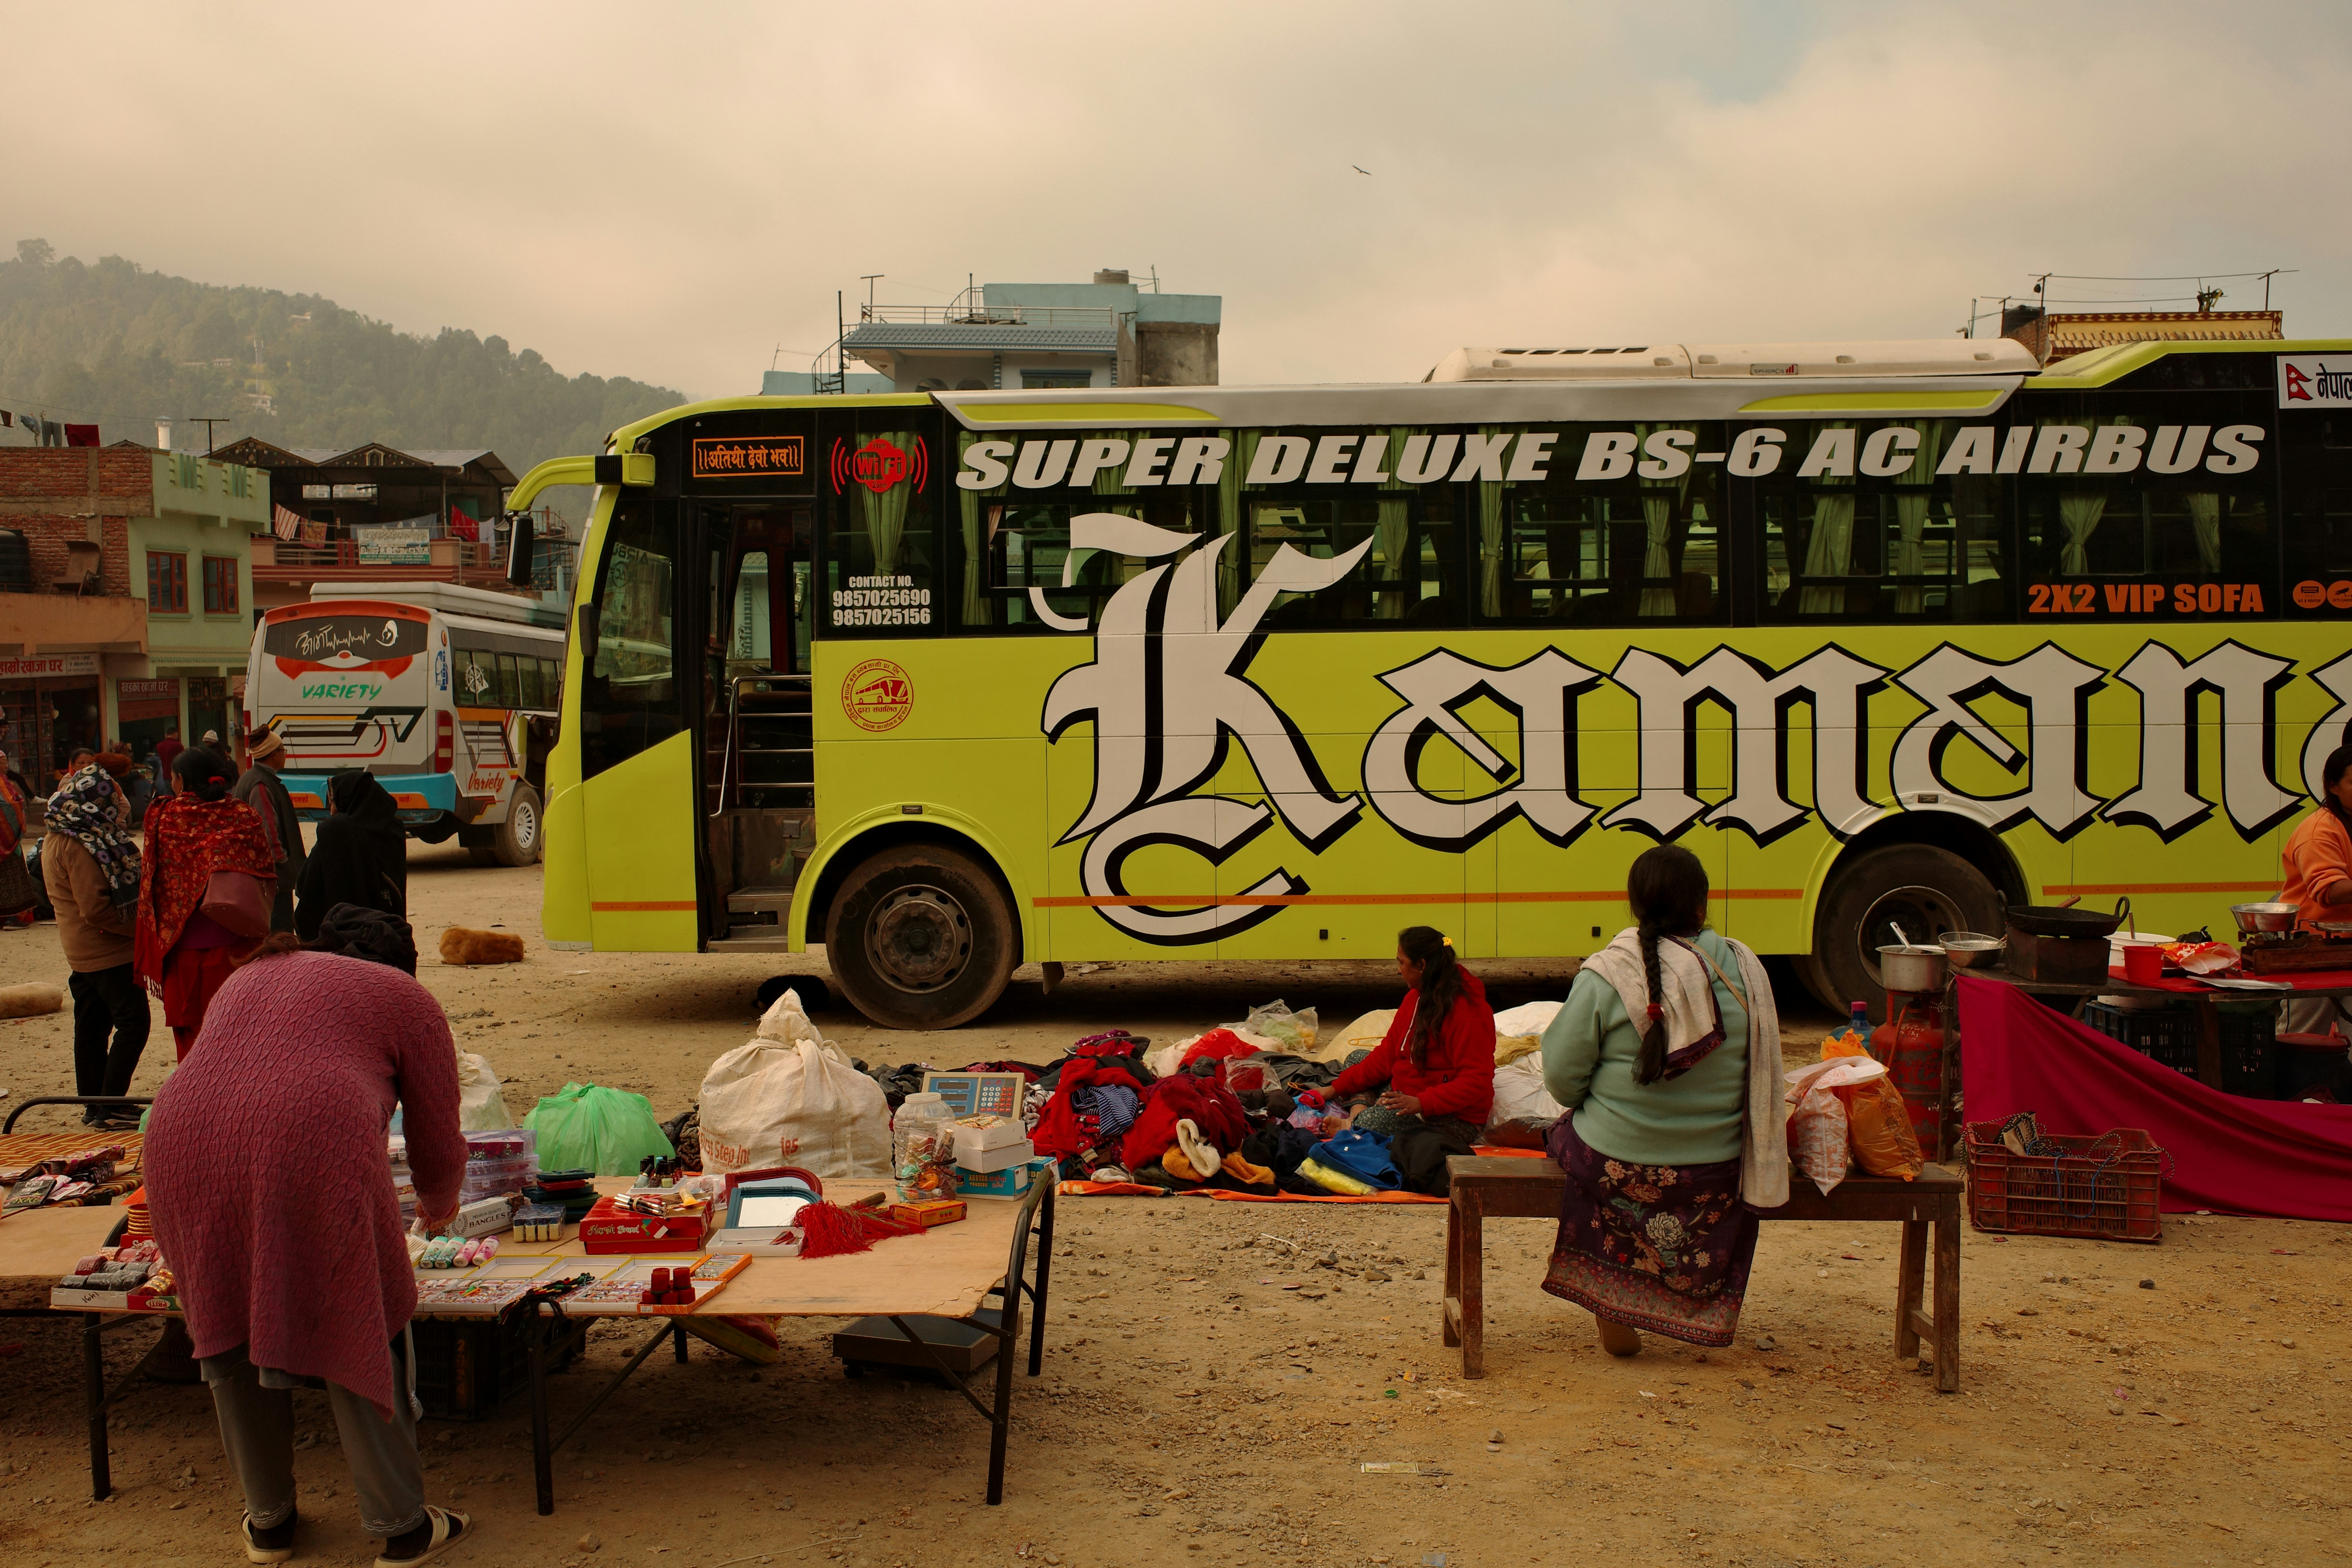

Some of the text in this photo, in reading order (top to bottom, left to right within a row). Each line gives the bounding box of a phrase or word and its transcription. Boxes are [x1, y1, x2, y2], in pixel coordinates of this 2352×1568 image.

[956, 425, 2266, 490] SUPER DELUXE BS-6 AC AIRBUS
[849, 575, 914, 588] CONTACT NO.
[833, 589, 930, 607] 9857025690
[2028, 584, 2264, 613] 2X2 VIP SOFA
[833, 608, 930, 626] 9857025156
[21, 661, 47, 673] खाजा
[49, 660, 63, 671] घर
[158, 682, 169, 691] घर
[302, 684, 382, 701] VARIETY
[468, 771, 505, 793] Variety
[715, 1141, 735, 1166] Step
[470, 1212, 505, 1228] BANGLES
[588, 1224, 639, 1235] Harsh Brand
